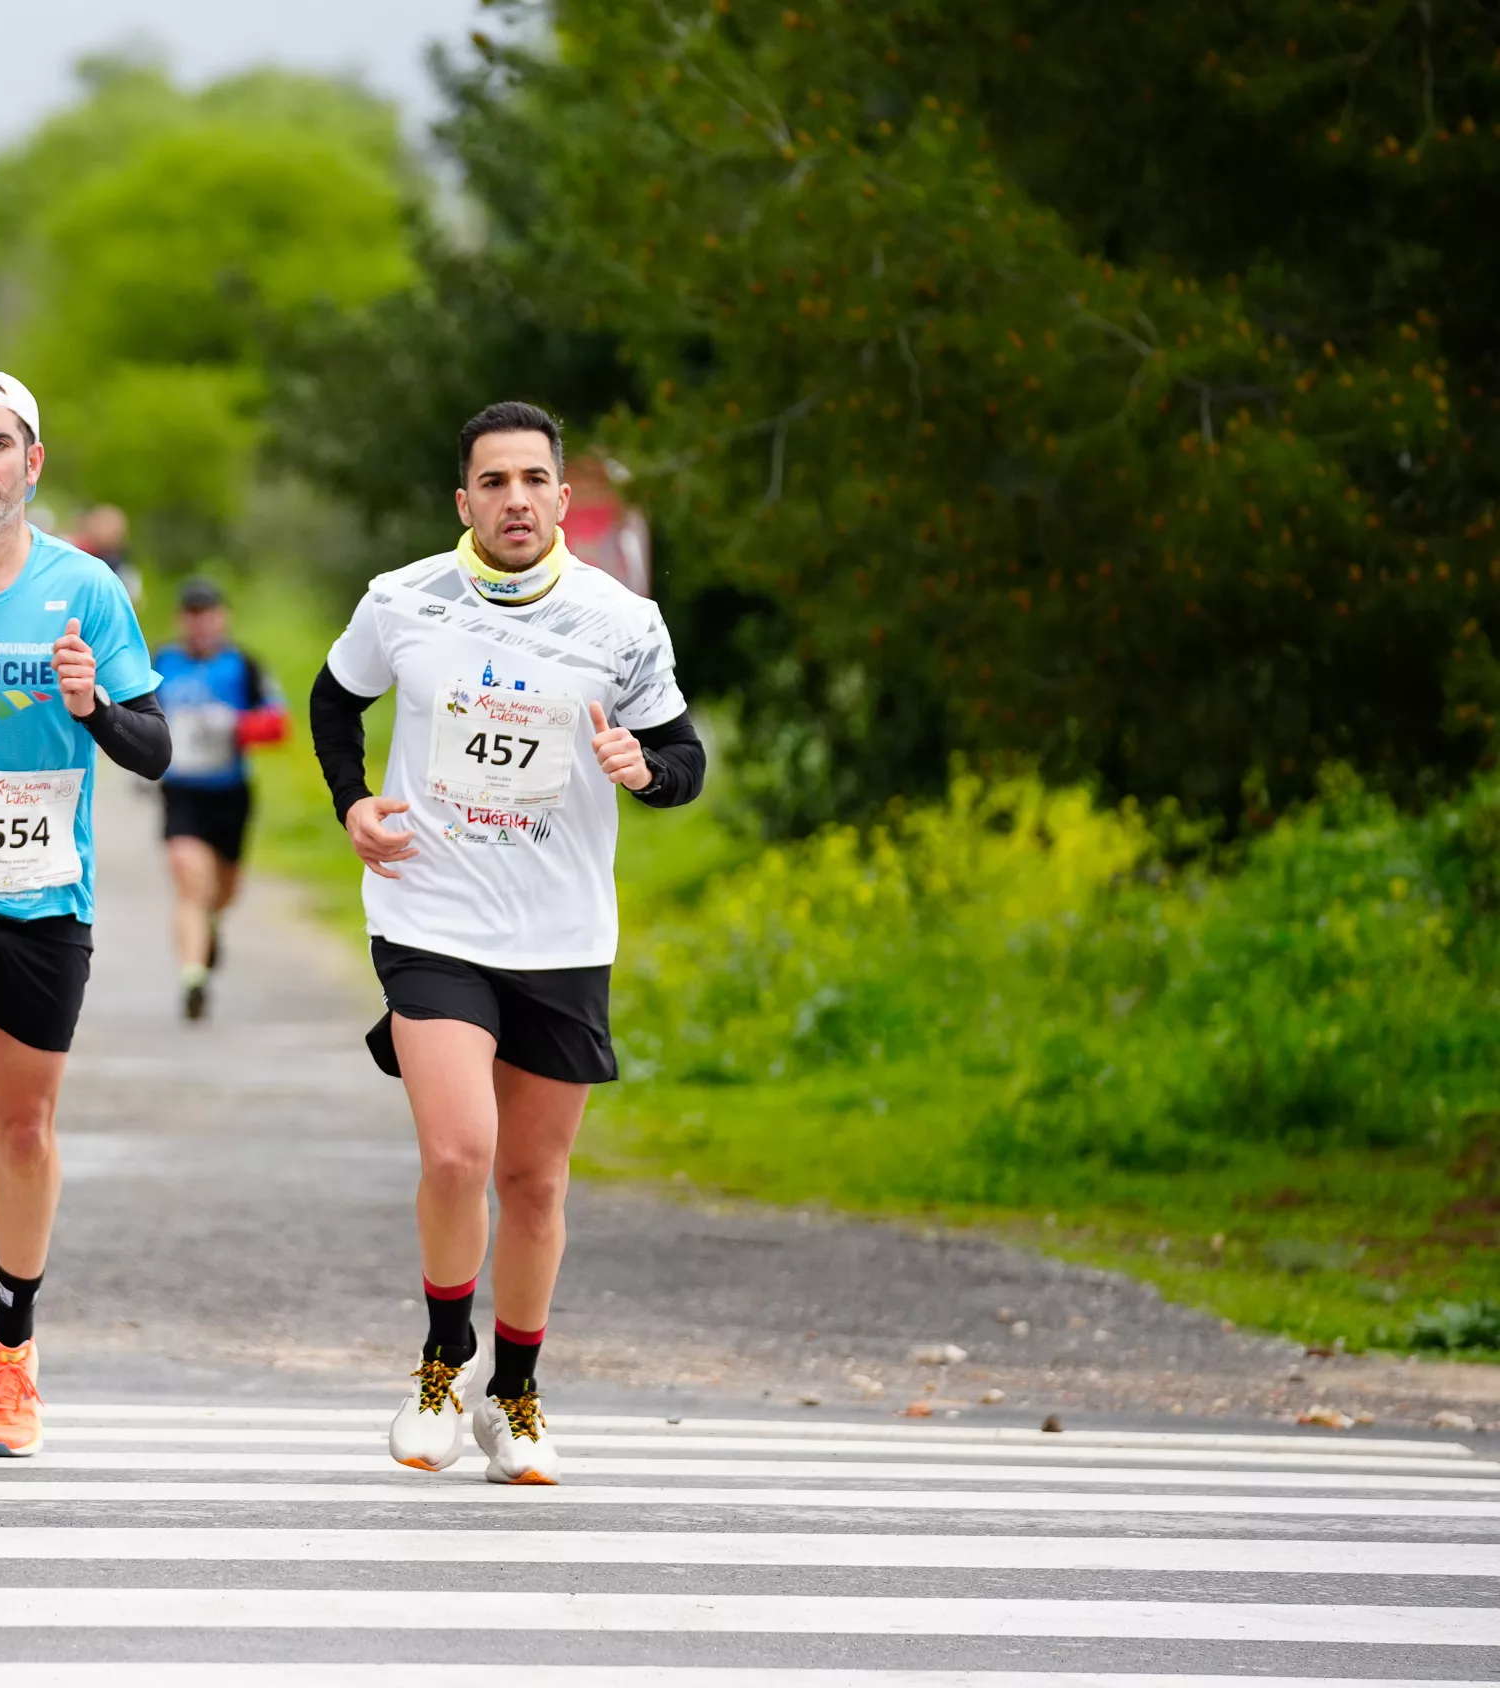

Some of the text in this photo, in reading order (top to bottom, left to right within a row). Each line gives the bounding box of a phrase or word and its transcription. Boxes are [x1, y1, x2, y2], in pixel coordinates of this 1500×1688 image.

[490, 709, 533, 727] LUCENA
[465, 732, 540, 769] 457
[467, 806, 537, 831] LUCENA
